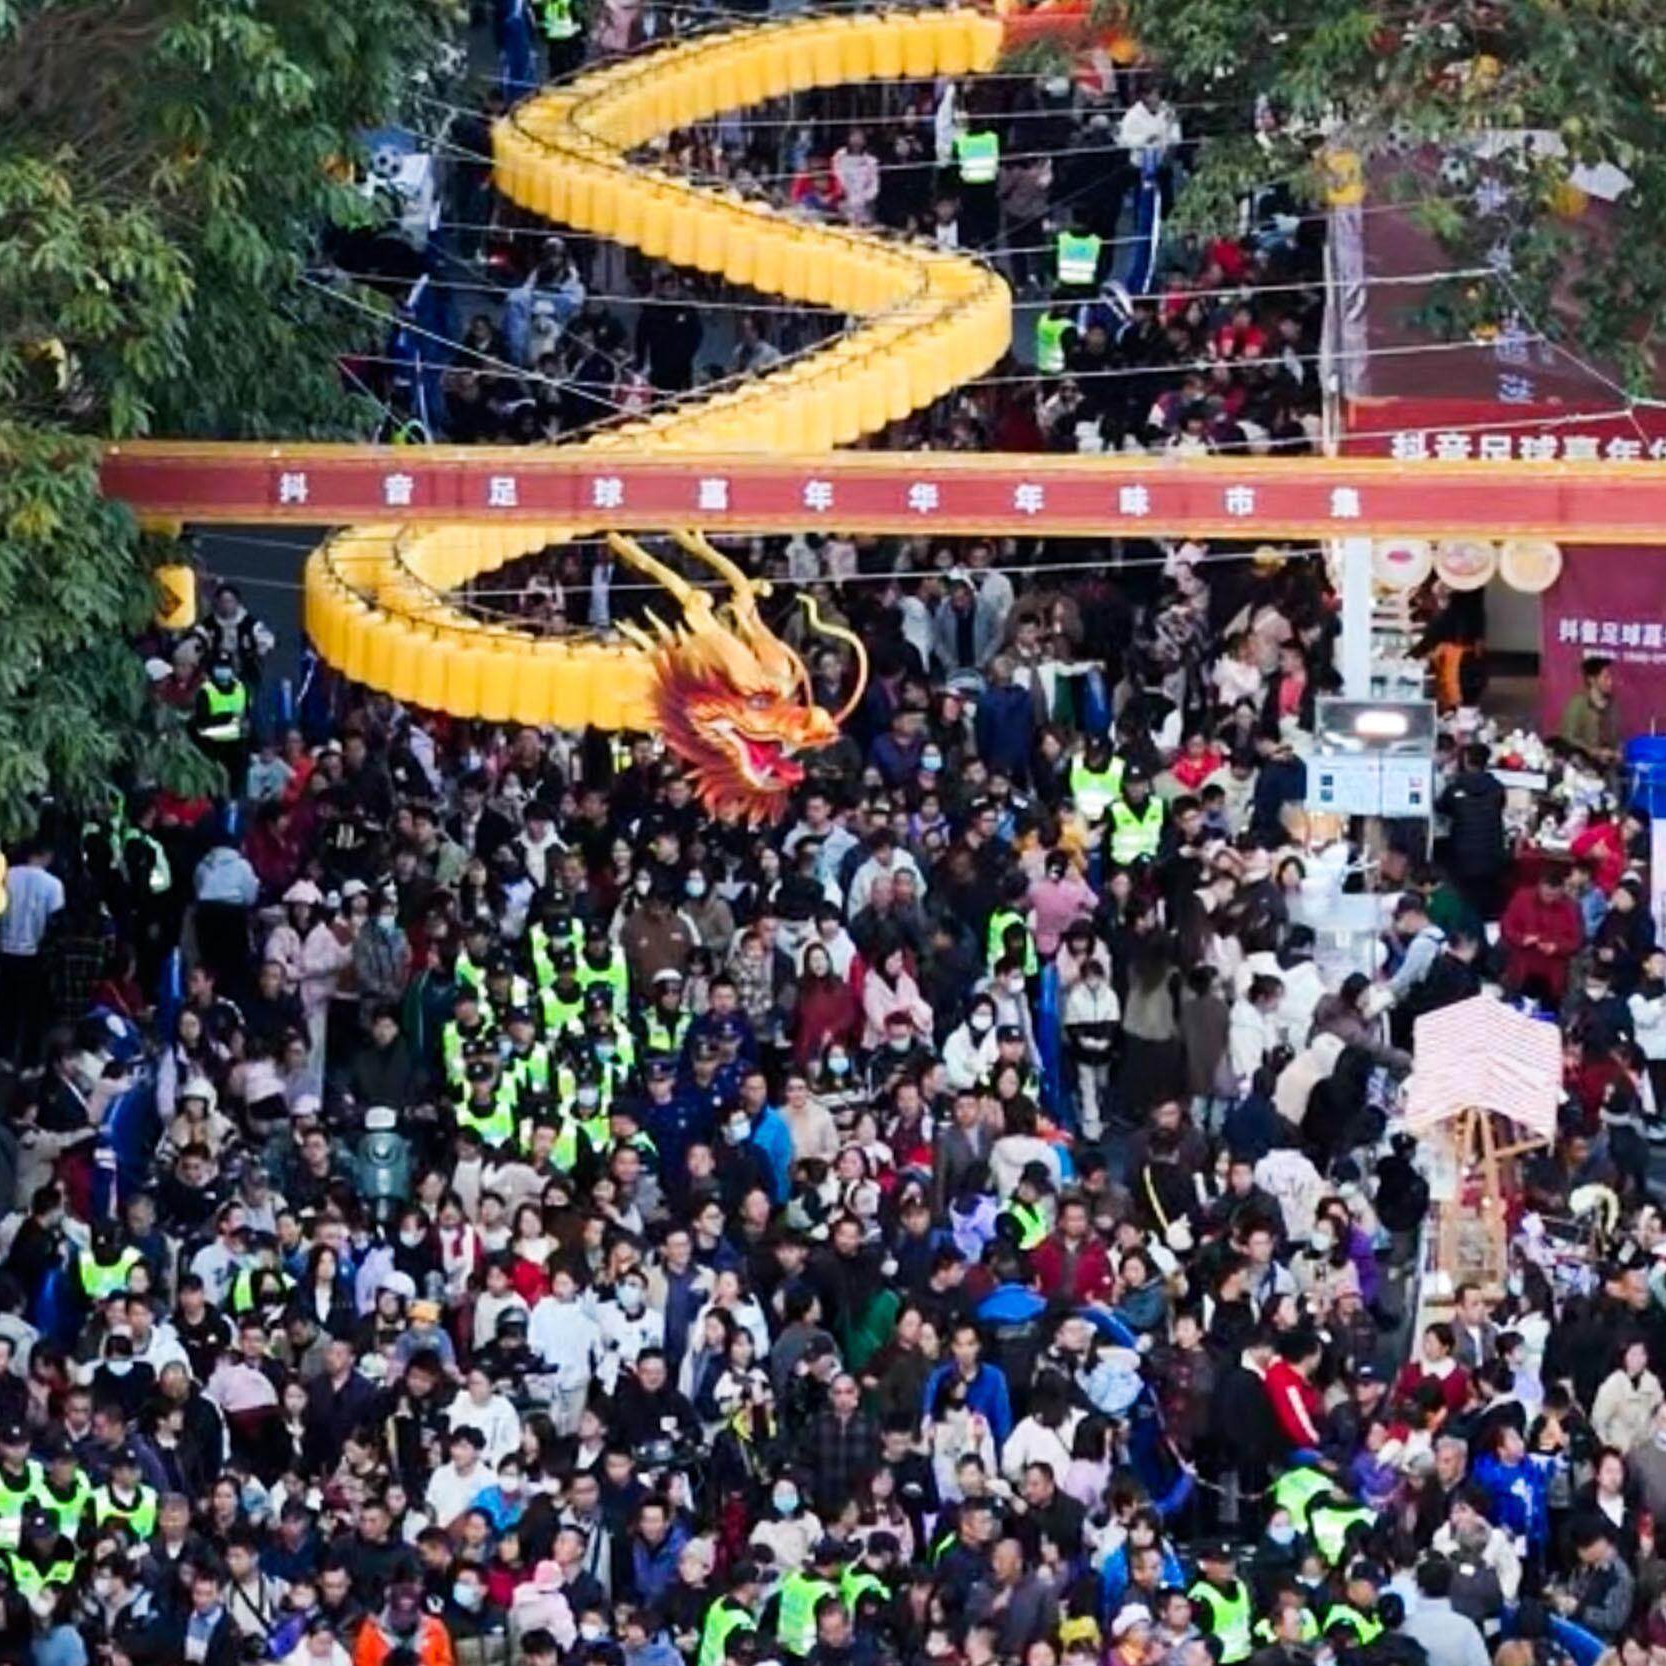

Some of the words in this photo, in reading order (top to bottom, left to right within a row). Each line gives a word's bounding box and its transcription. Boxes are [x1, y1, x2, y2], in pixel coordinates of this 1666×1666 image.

[279, 472, 1360, 518] 抖音足球嘉年华年味市集
